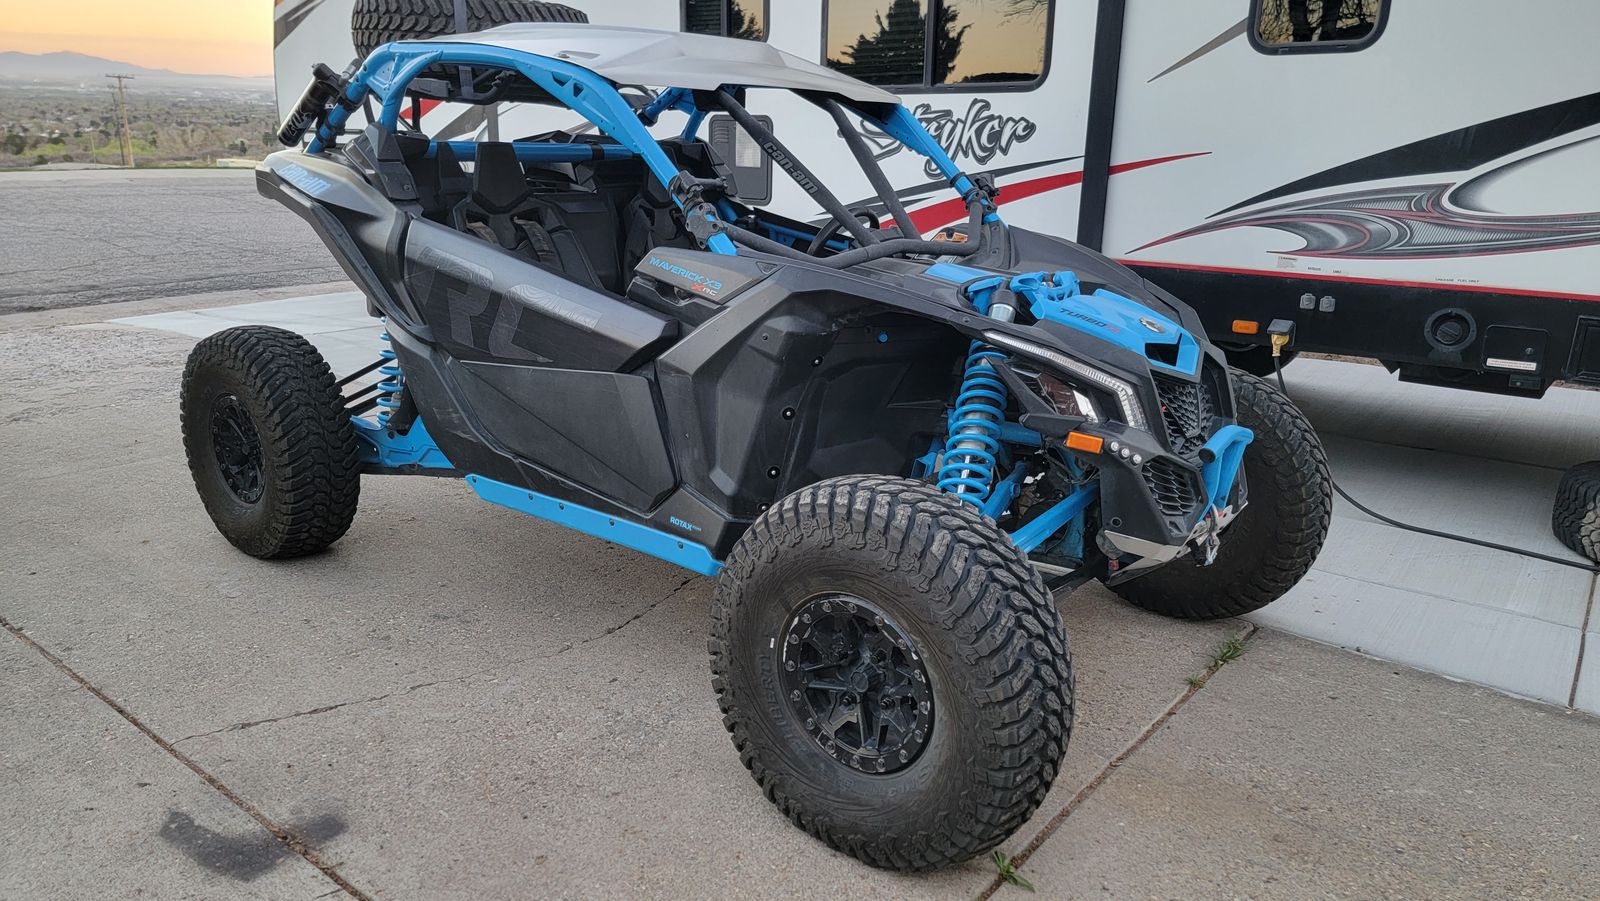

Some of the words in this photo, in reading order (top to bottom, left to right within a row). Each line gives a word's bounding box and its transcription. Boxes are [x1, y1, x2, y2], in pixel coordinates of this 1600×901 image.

[279, 163, 332, 195] can-am
[763, 141, 818, 194] can-am
[649, 256, 704, 284] MAVERICK
[703, 277, 722, 290] X3
[670, 515, 692, 531] ROTAX
